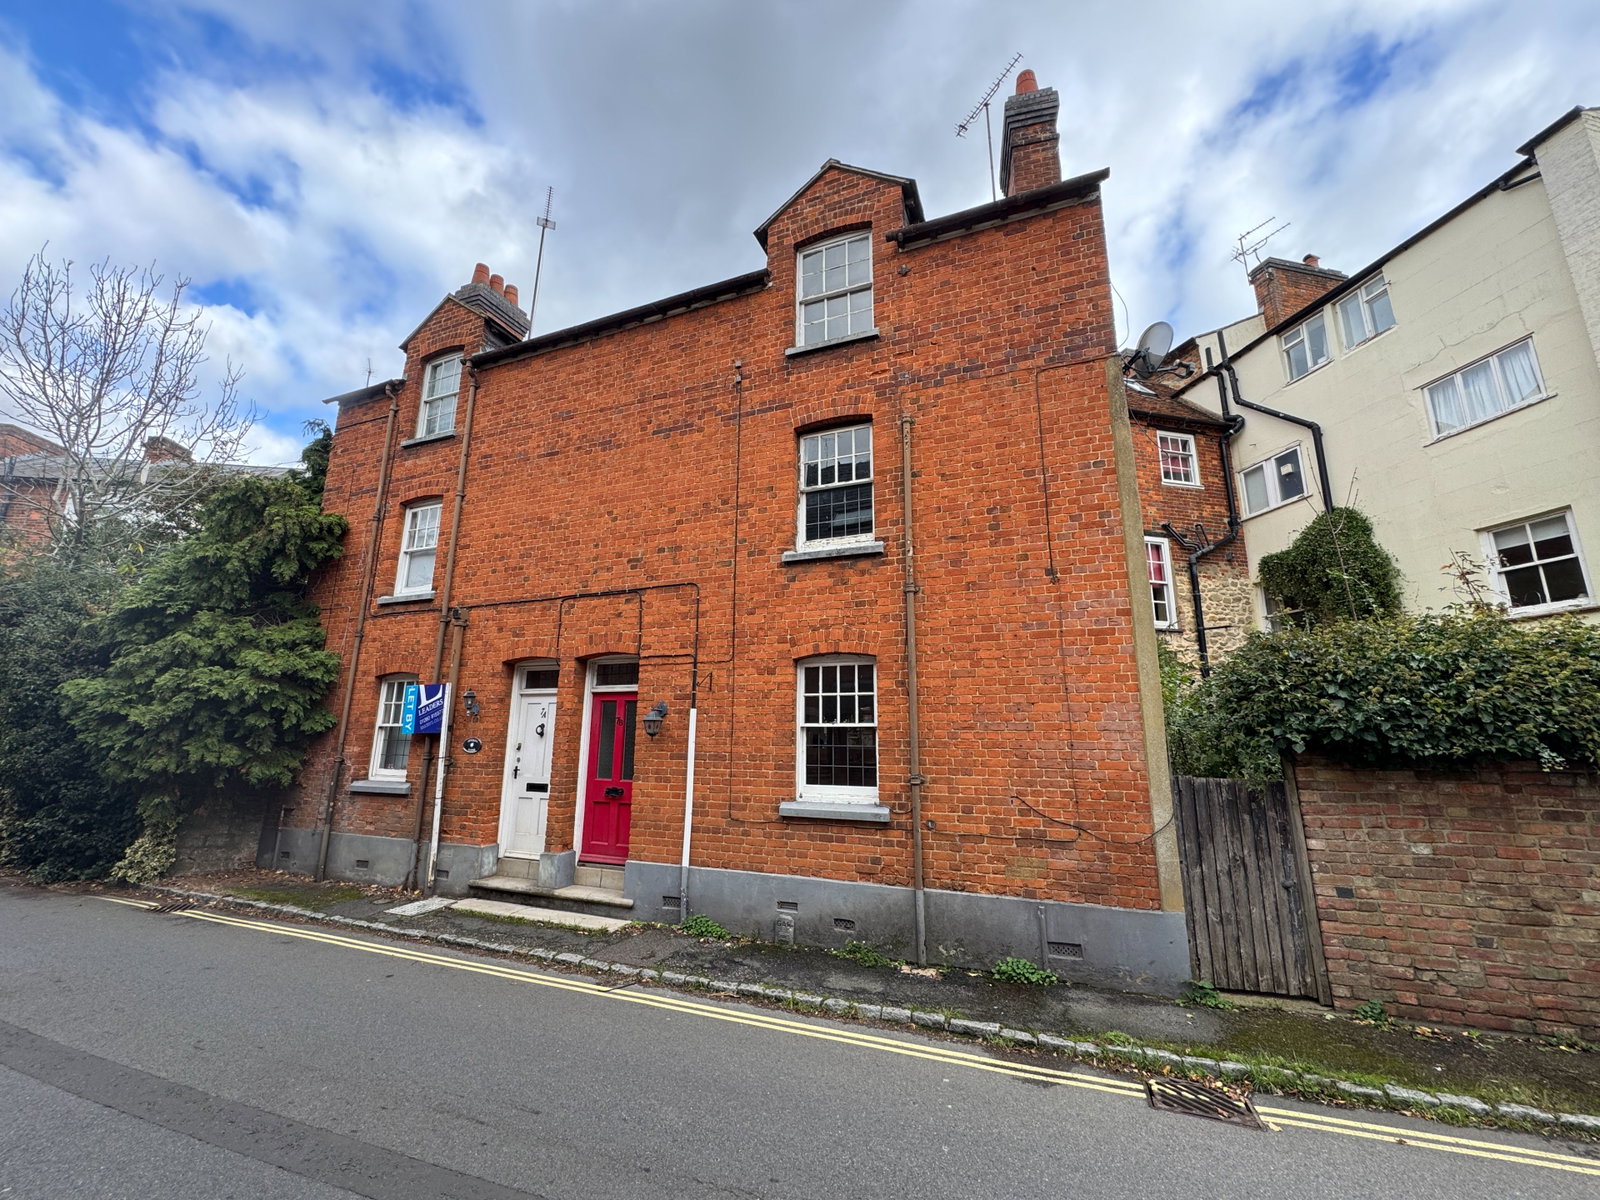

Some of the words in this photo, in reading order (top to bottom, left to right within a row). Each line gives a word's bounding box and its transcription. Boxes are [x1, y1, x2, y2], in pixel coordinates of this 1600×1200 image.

[407, 688, 416, 710] LET
[418, 698, 444, 716] LEADERS
[405, 714, 413, 730] BY
